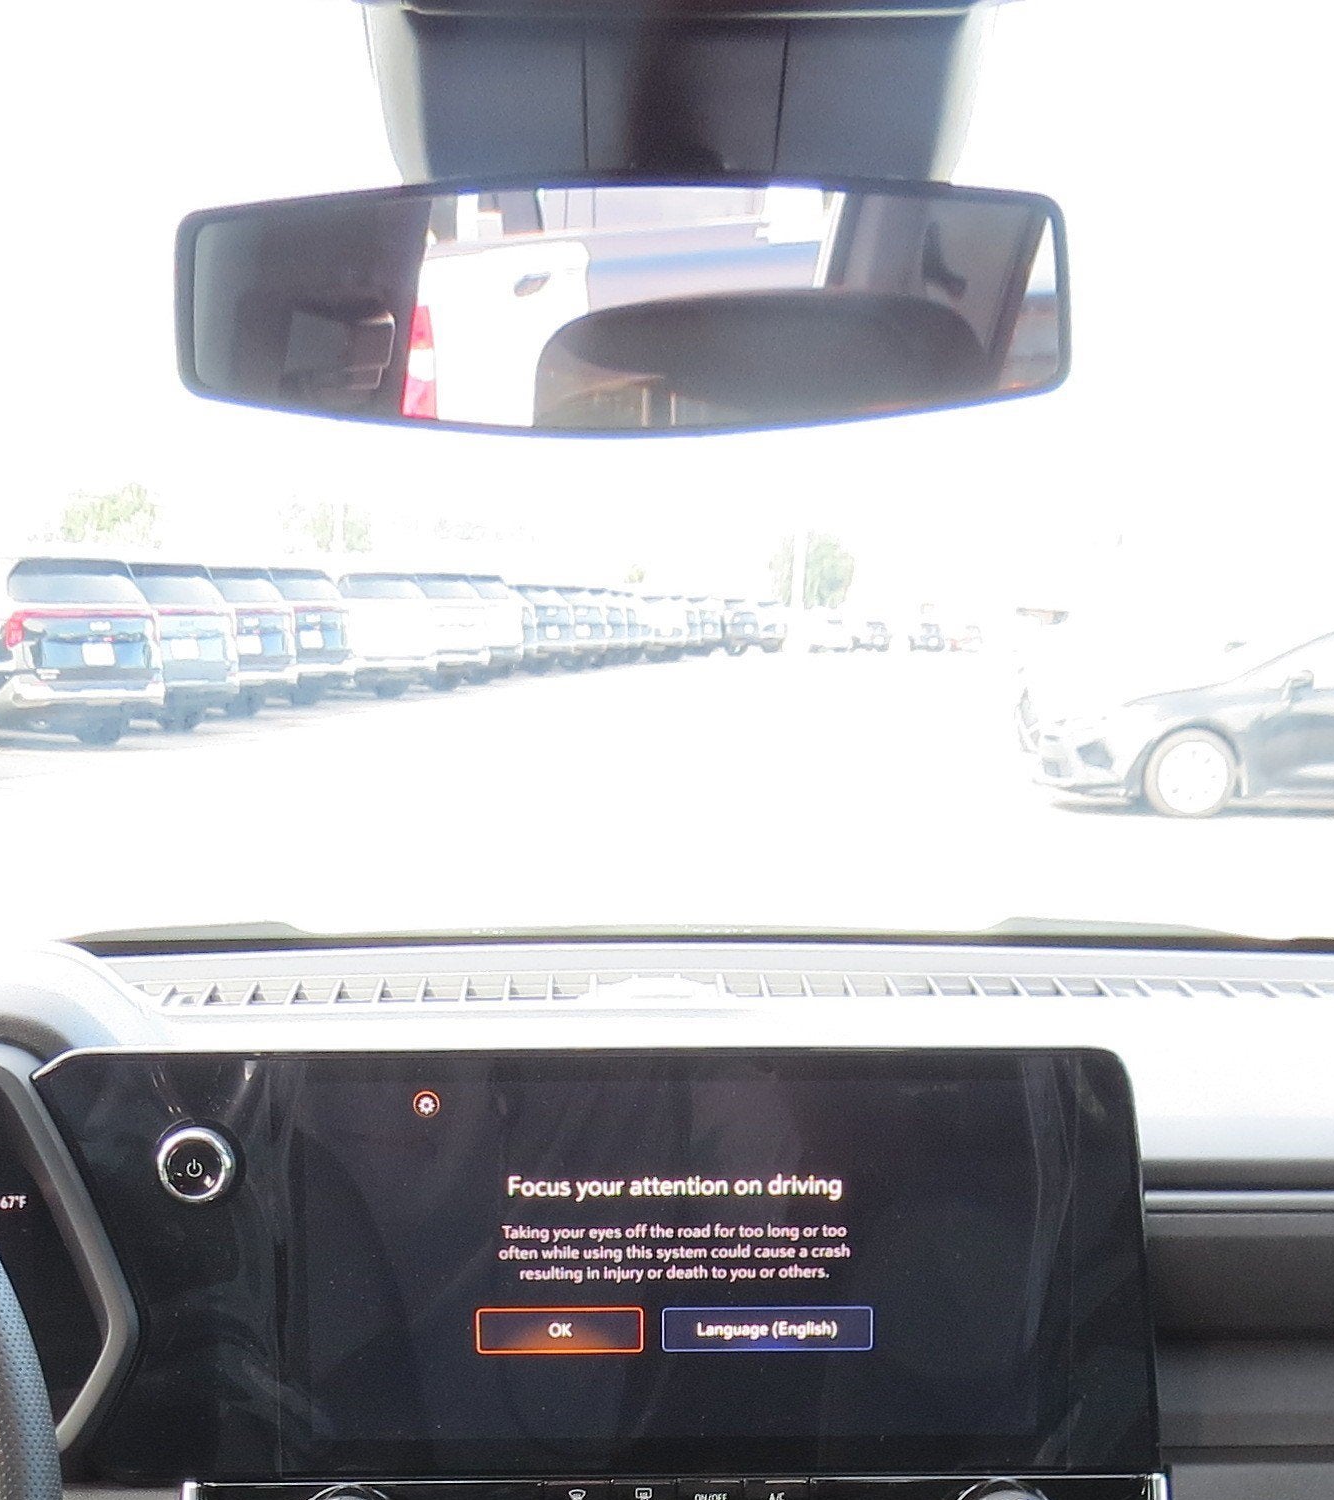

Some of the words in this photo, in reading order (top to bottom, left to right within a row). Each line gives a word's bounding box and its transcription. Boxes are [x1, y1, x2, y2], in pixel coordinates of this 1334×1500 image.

[508, 1176, 571, 1196] Focus
[576, 1180, 625, 1202] your
[629, 1175, 728, 1196] attention
[734, 1180, 762, 1195] on
[768, 1174, 842, 1201] driving
[501, 1225, 550, 1242] Taking
[552, 1229, 586, 1242] your
[588, 1228, 623, 1242] eyes
[624, 1224, 648, 1238] off
[649, 1224, 674, 1238] the
[677, 1224, 711, 1238] road
[713, 1223, 736, 1237] for
[738, 1225, 765, 1237] too
[767, 1223, 800, 1241] long
[802, 1227, 820, 1237] or
[821, 1225, 848, 1237] too
[498, 1246, 539, 1260] often
[541, 1245, 580, 1259] while
[582, 1246, 623, 1263] using
[625, 1245, 653, 1259] this
[656, 1246, 708, 1262] system
[710, 1244, 751, 1258] could
[753, 1248, 797, 1258] cause
[798, 1248, 809, 1257] a
[810, 1244, 851, 1257] crash
[519, 1266, 583, 1283] resulting
[586, 1267, 600, 1279] in
[603, 1266, 645, 1283] injury
[647, 1269, 664, 1279] or
[665, 1265, 709, 1279] death
[711, 1267, 728, 1279] to
[729, 1269, 757, 1282] you
[759, 1268, 776, 1278] or
[778, 1264, 830, 1278] others.
[548, 1323, 572, 1338] OK
[696, 1322, 769, 1342] Language
[771, 1322, 838, 1339] (English)
